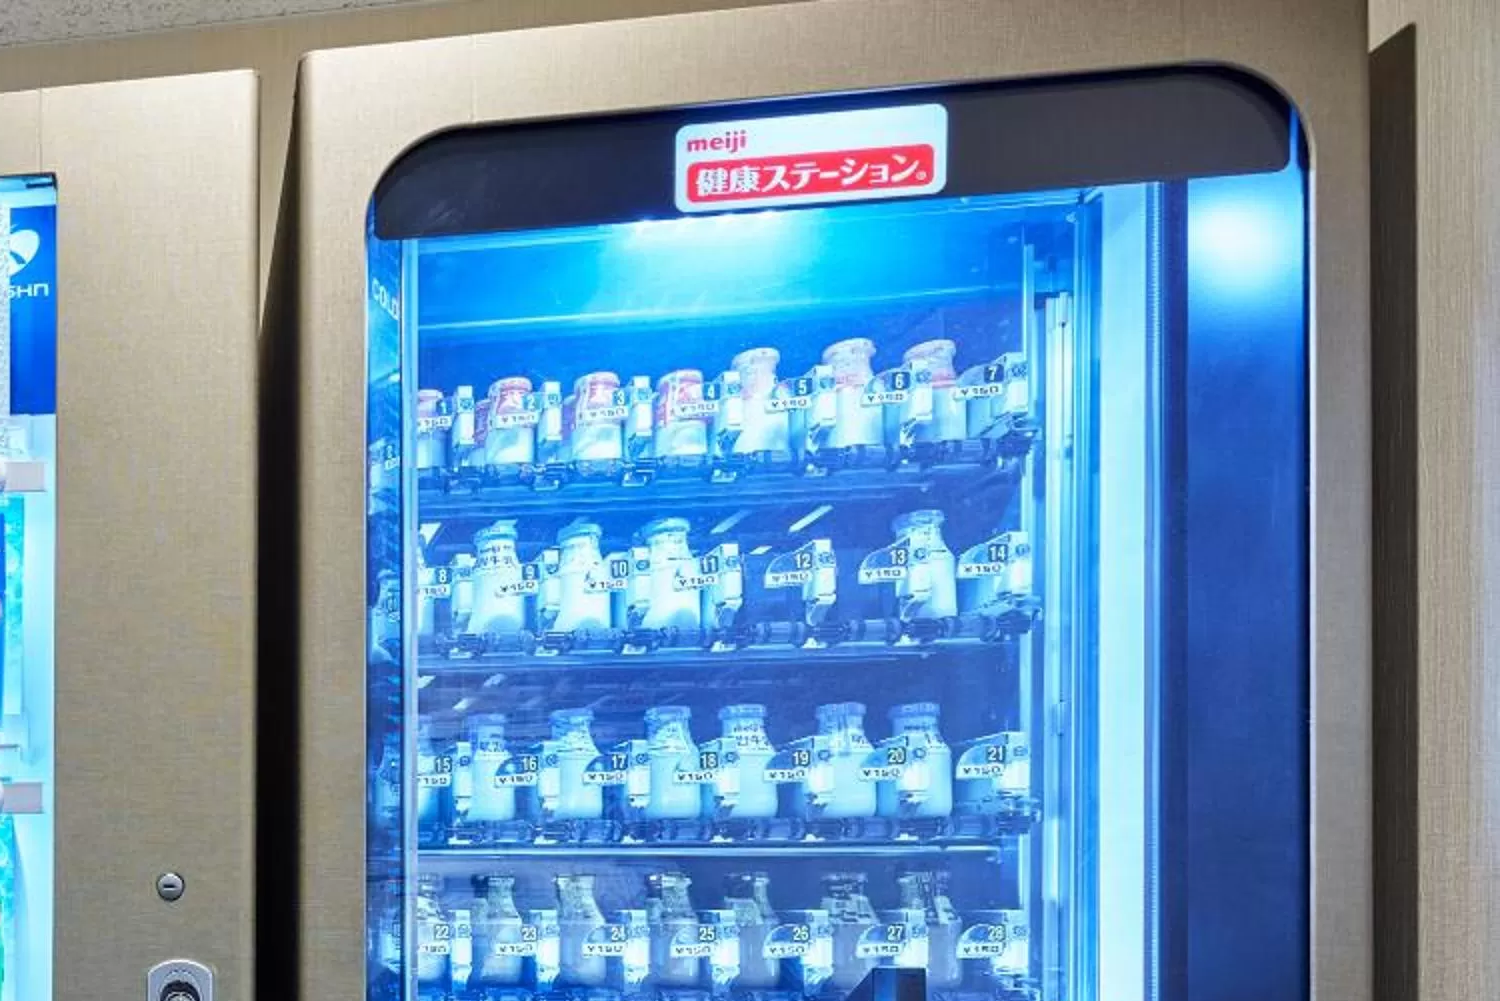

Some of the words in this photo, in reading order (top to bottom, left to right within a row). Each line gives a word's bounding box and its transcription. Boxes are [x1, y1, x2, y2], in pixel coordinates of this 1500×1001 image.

[686, 130, 747, 153] meiji
[696, 155, 920, 197] 健康ステーション
[701, 558, 717, 573] 11
[796, 552, 812, 568] 12
[611, 561, 627, 577] 10
[611, 754, 627, 769] 17
[700, 752, 717, 768] 18
[793, 751, 809, 766] 19
[988, 747, 1005, 762] 21
[435, 757, 450, 772] 15
[521, 756, 537, 771] 16
[435, 925, 450, 940] 22
[522, 926, 537, 941] 23
[611, 926, 626, 941] 24
[700, 926, 715, 941] 25
[793, 925, 809, 940] 26
[887, 925, 904, 940] 27
